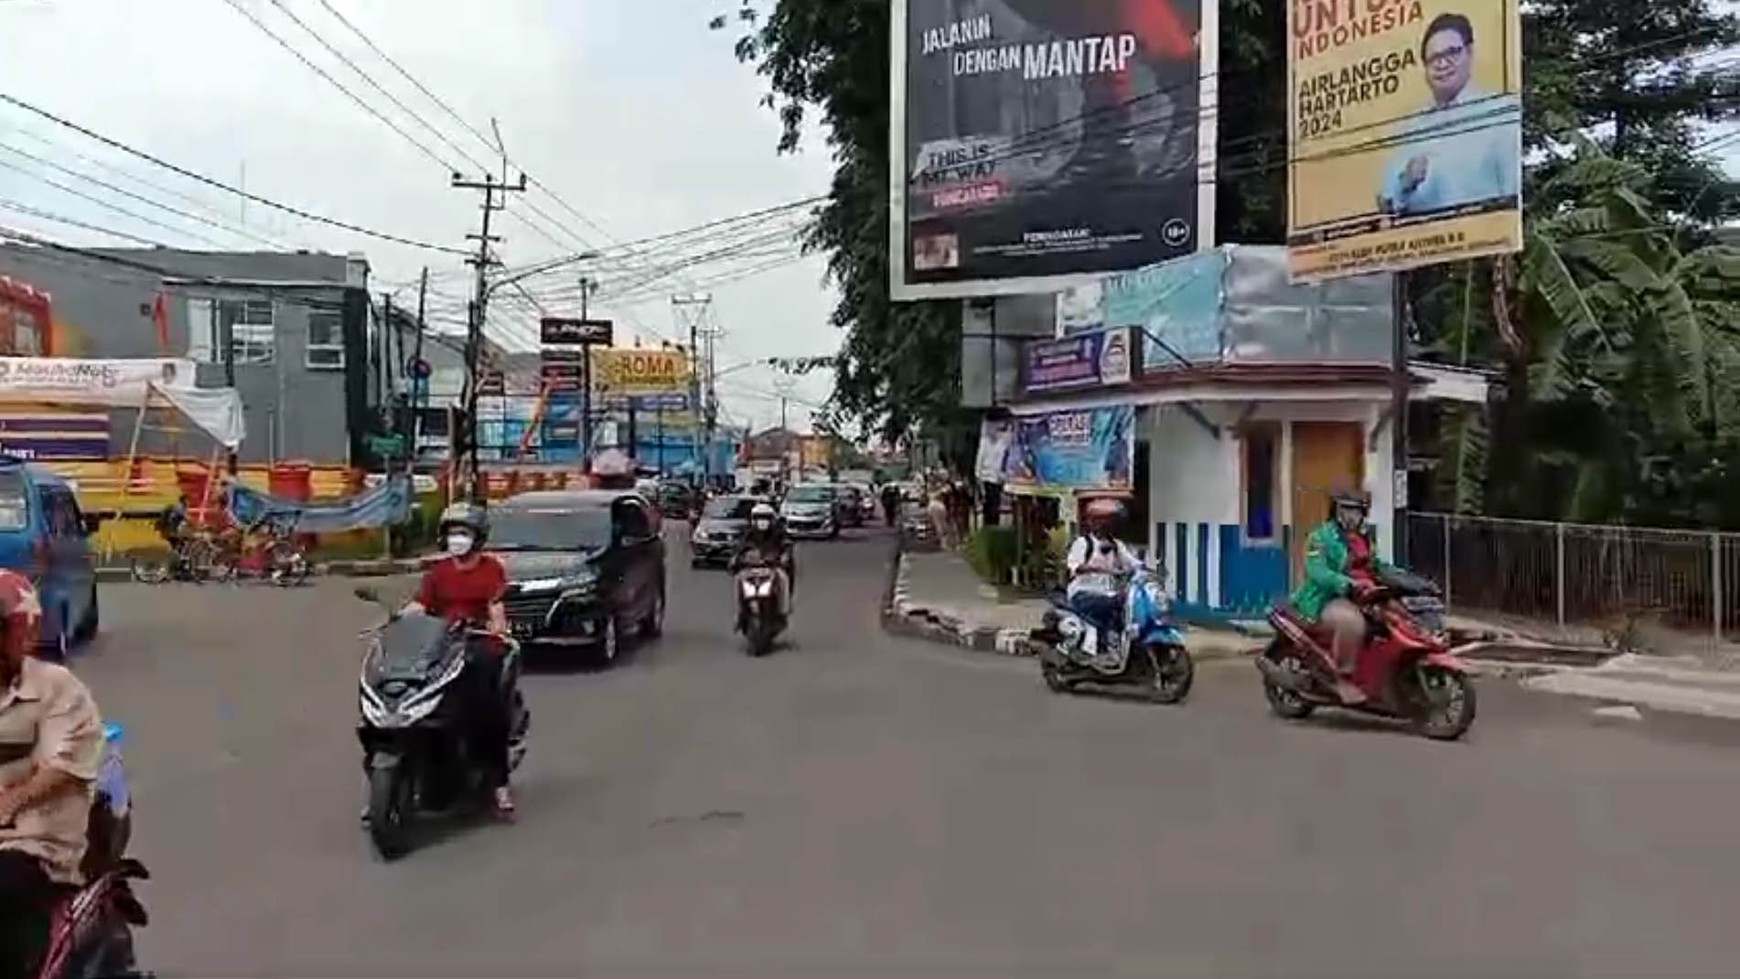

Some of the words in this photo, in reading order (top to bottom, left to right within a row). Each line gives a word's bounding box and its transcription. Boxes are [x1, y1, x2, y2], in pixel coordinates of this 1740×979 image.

[922, 13, 991, 55] JALANIN
[954, 45, 1021, 76] DENGAN
[1023, 34, 1136, 80] MANTAP
[1299, 48, 1417, 98] AIRLANGGA
[1299, 75, 1400, 119] HARTARTO
[1299, 110, 1342, 138] 2024
[928, 147, 968, 167] THIS
[973, 143, 990, 160] IS
[620, 355, 675, 375] ROMA
